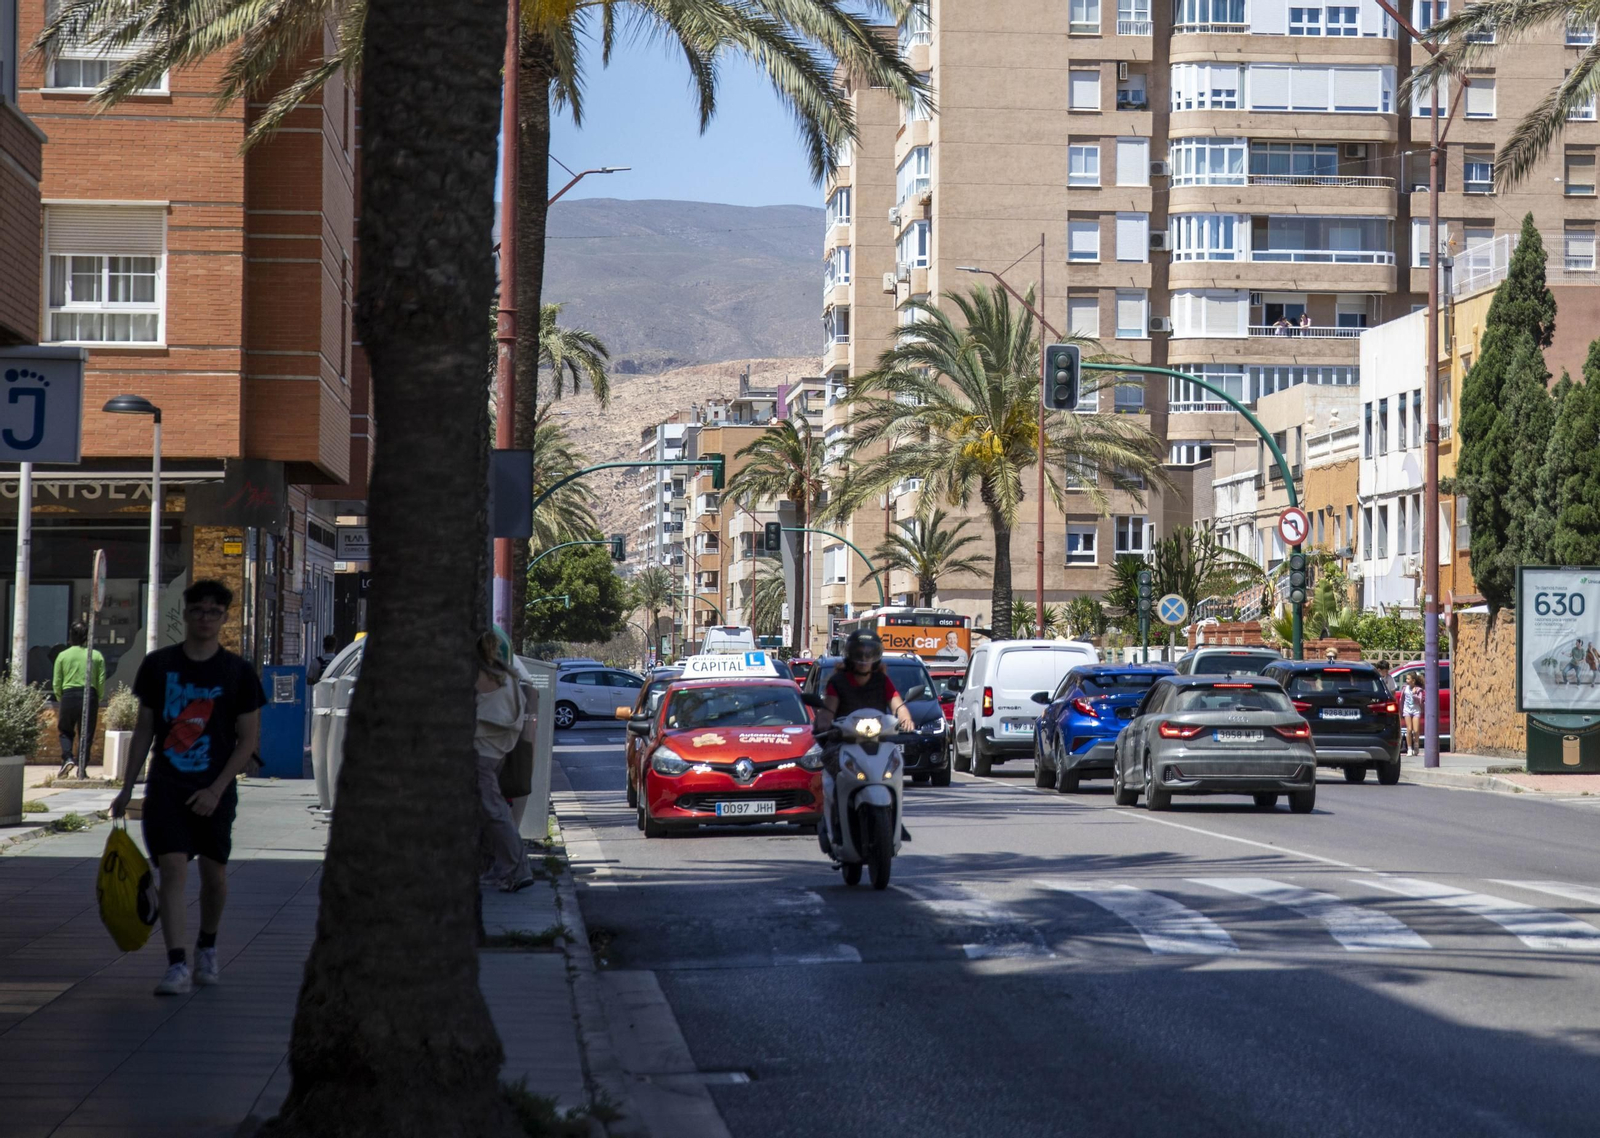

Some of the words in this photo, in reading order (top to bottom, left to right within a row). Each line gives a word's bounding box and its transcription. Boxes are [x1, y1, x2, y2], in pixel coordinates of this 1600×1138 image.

[1534, 591, 1585, 616] 630
[881, 633, 941, 649] Flexicar
[749, 653, 761, 665] L
[692, 661, 744, 672] CAPITAL
[723, 803, 750, 814] 0097
[753, 803, 774, 813] JHH
